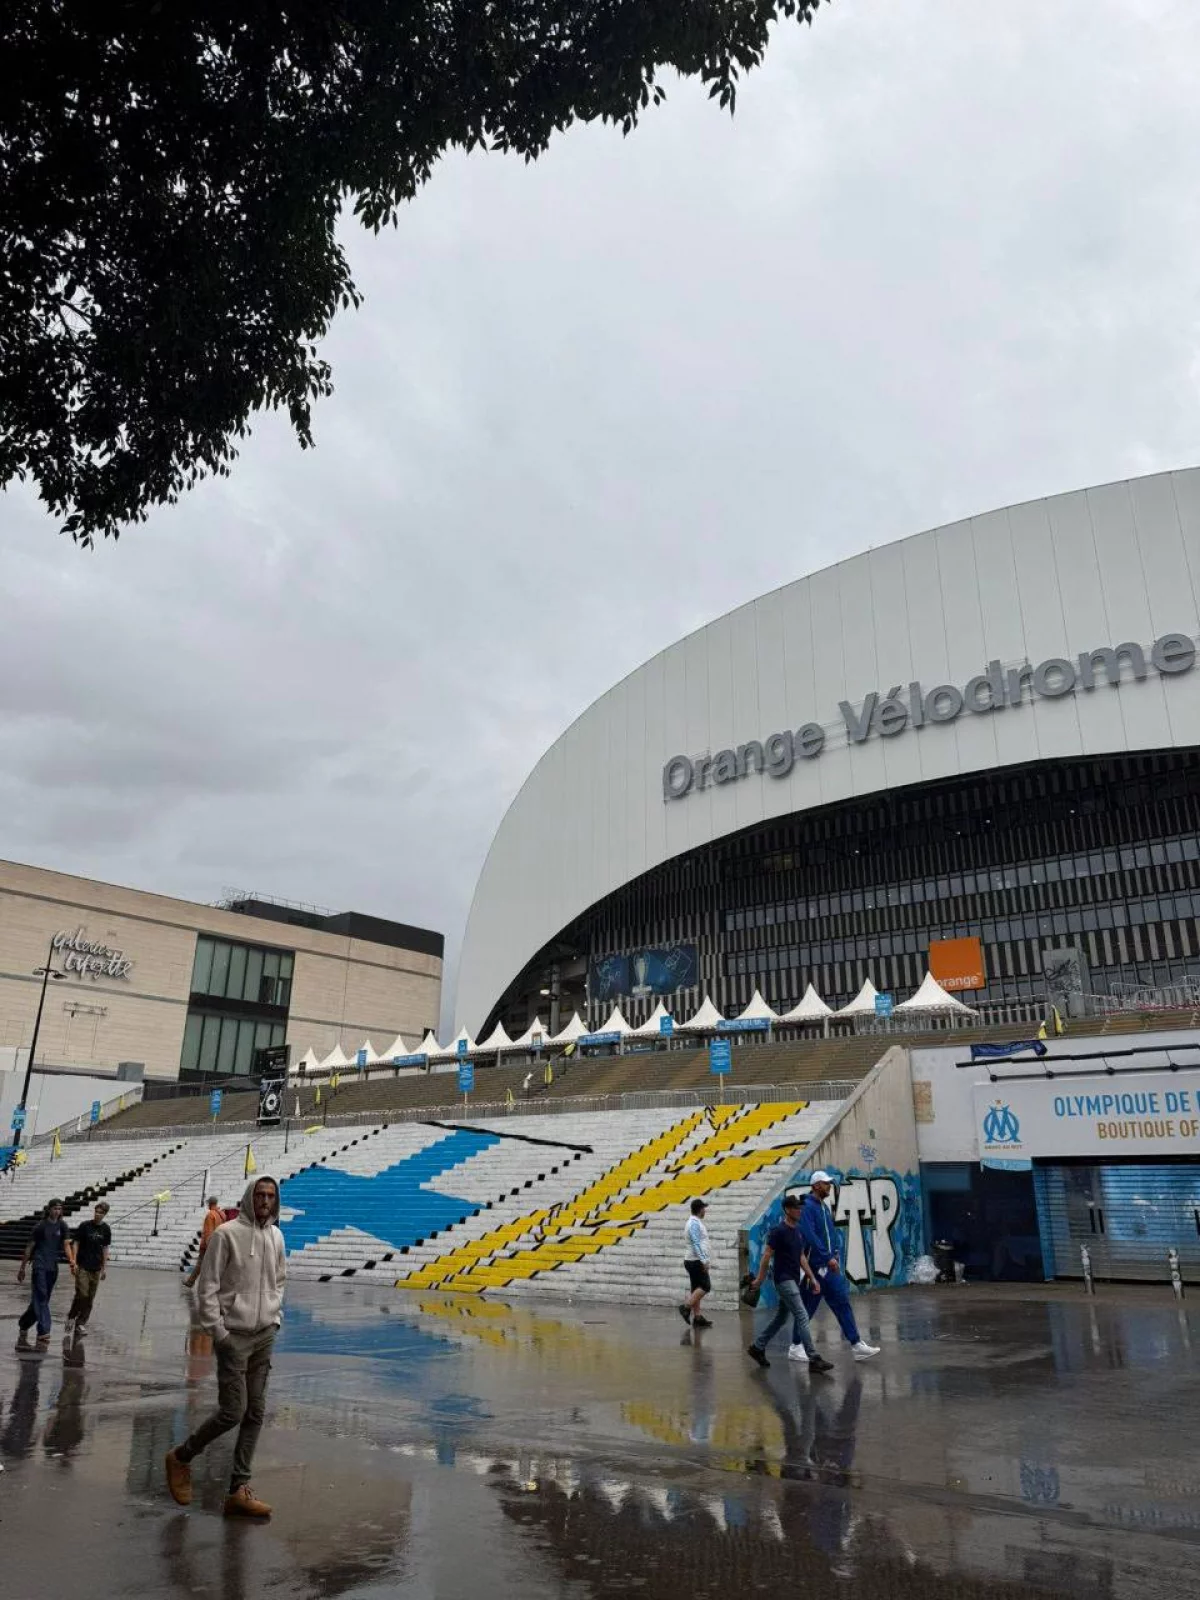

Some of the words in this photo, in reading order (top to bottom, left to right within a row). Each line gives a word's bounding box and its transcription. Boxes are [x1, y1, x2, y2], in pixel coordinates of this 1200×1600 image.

[662, 719, 825, 802] Orange
[838, 632, 1196, 742] Vélodrome
[936, 975, 979, 988] orange
[1054, 1092, 1160, 1117] OLYMPIQUE
[1165, 1090, 1191, 1113] DE
[1097, 1119, 1175, 1139] BOUTIQUE
